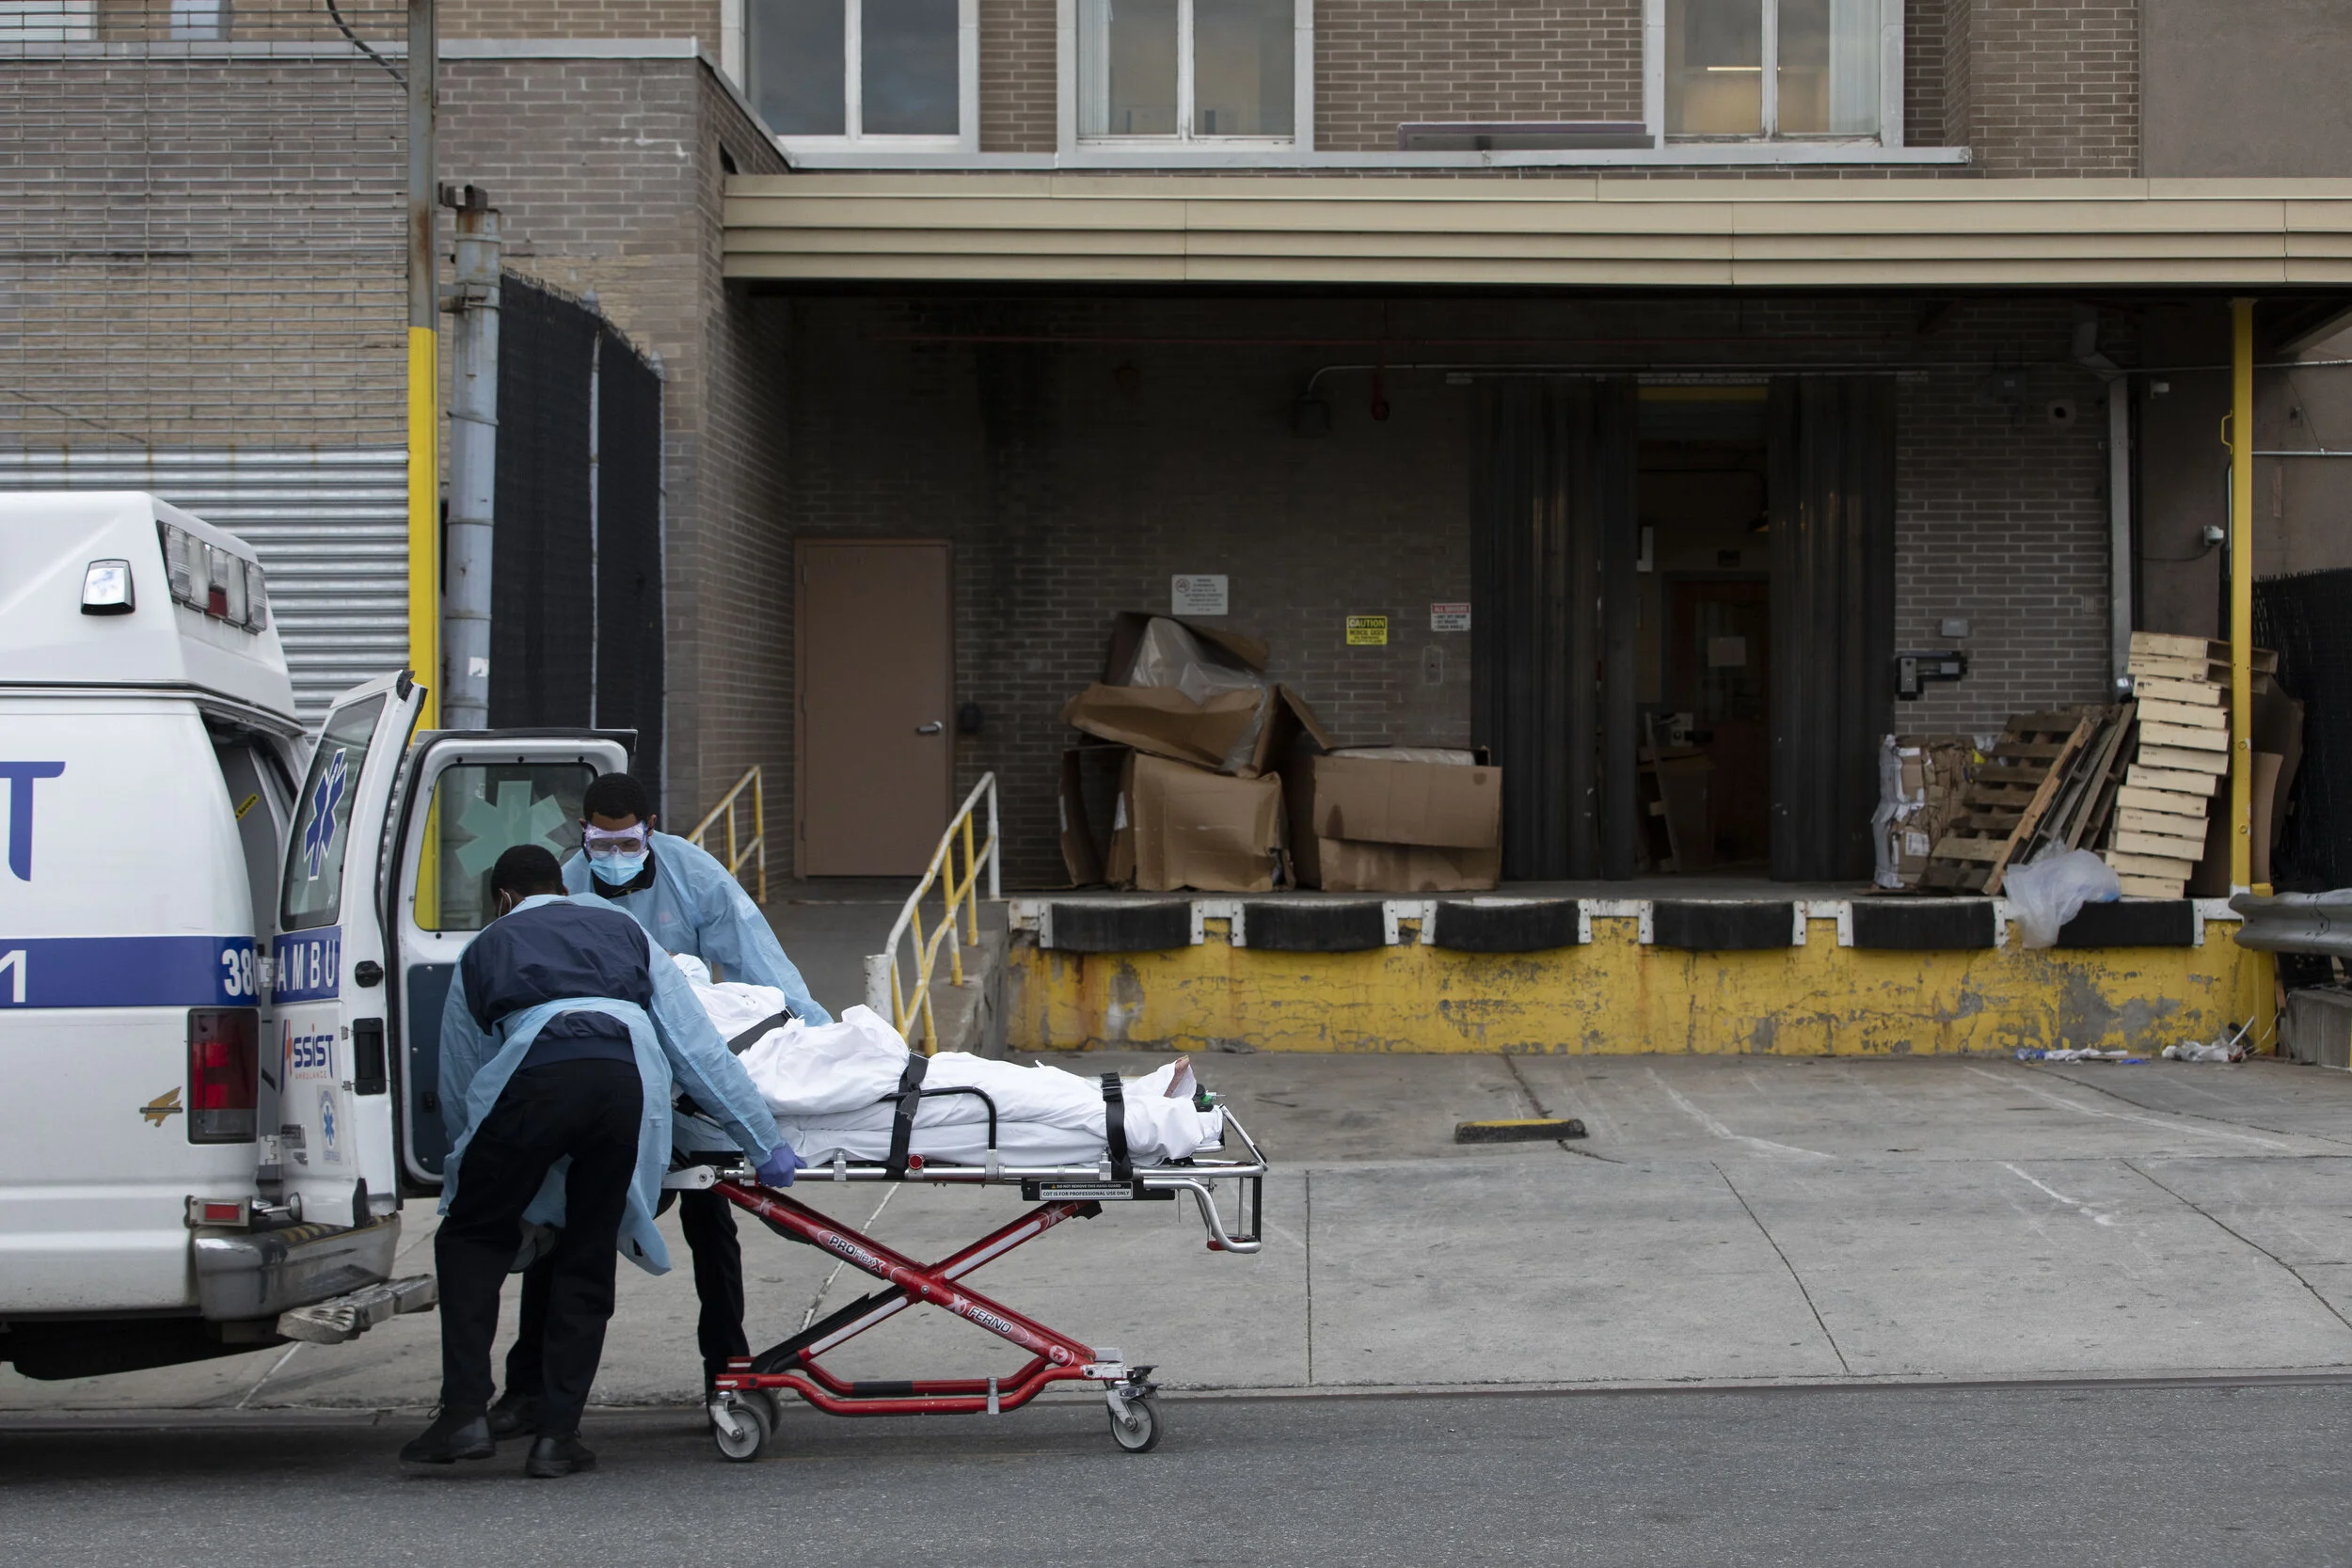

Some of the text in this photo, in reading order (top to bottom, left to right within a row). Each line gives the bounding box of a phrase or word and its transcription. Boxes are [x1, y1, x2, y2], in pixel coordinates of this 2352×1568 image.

[1349, 619, 1385, 627] CAUTION
[277, 940, 336, 992] AMBU
[968, 1307, 1012, 1334] FERNO
